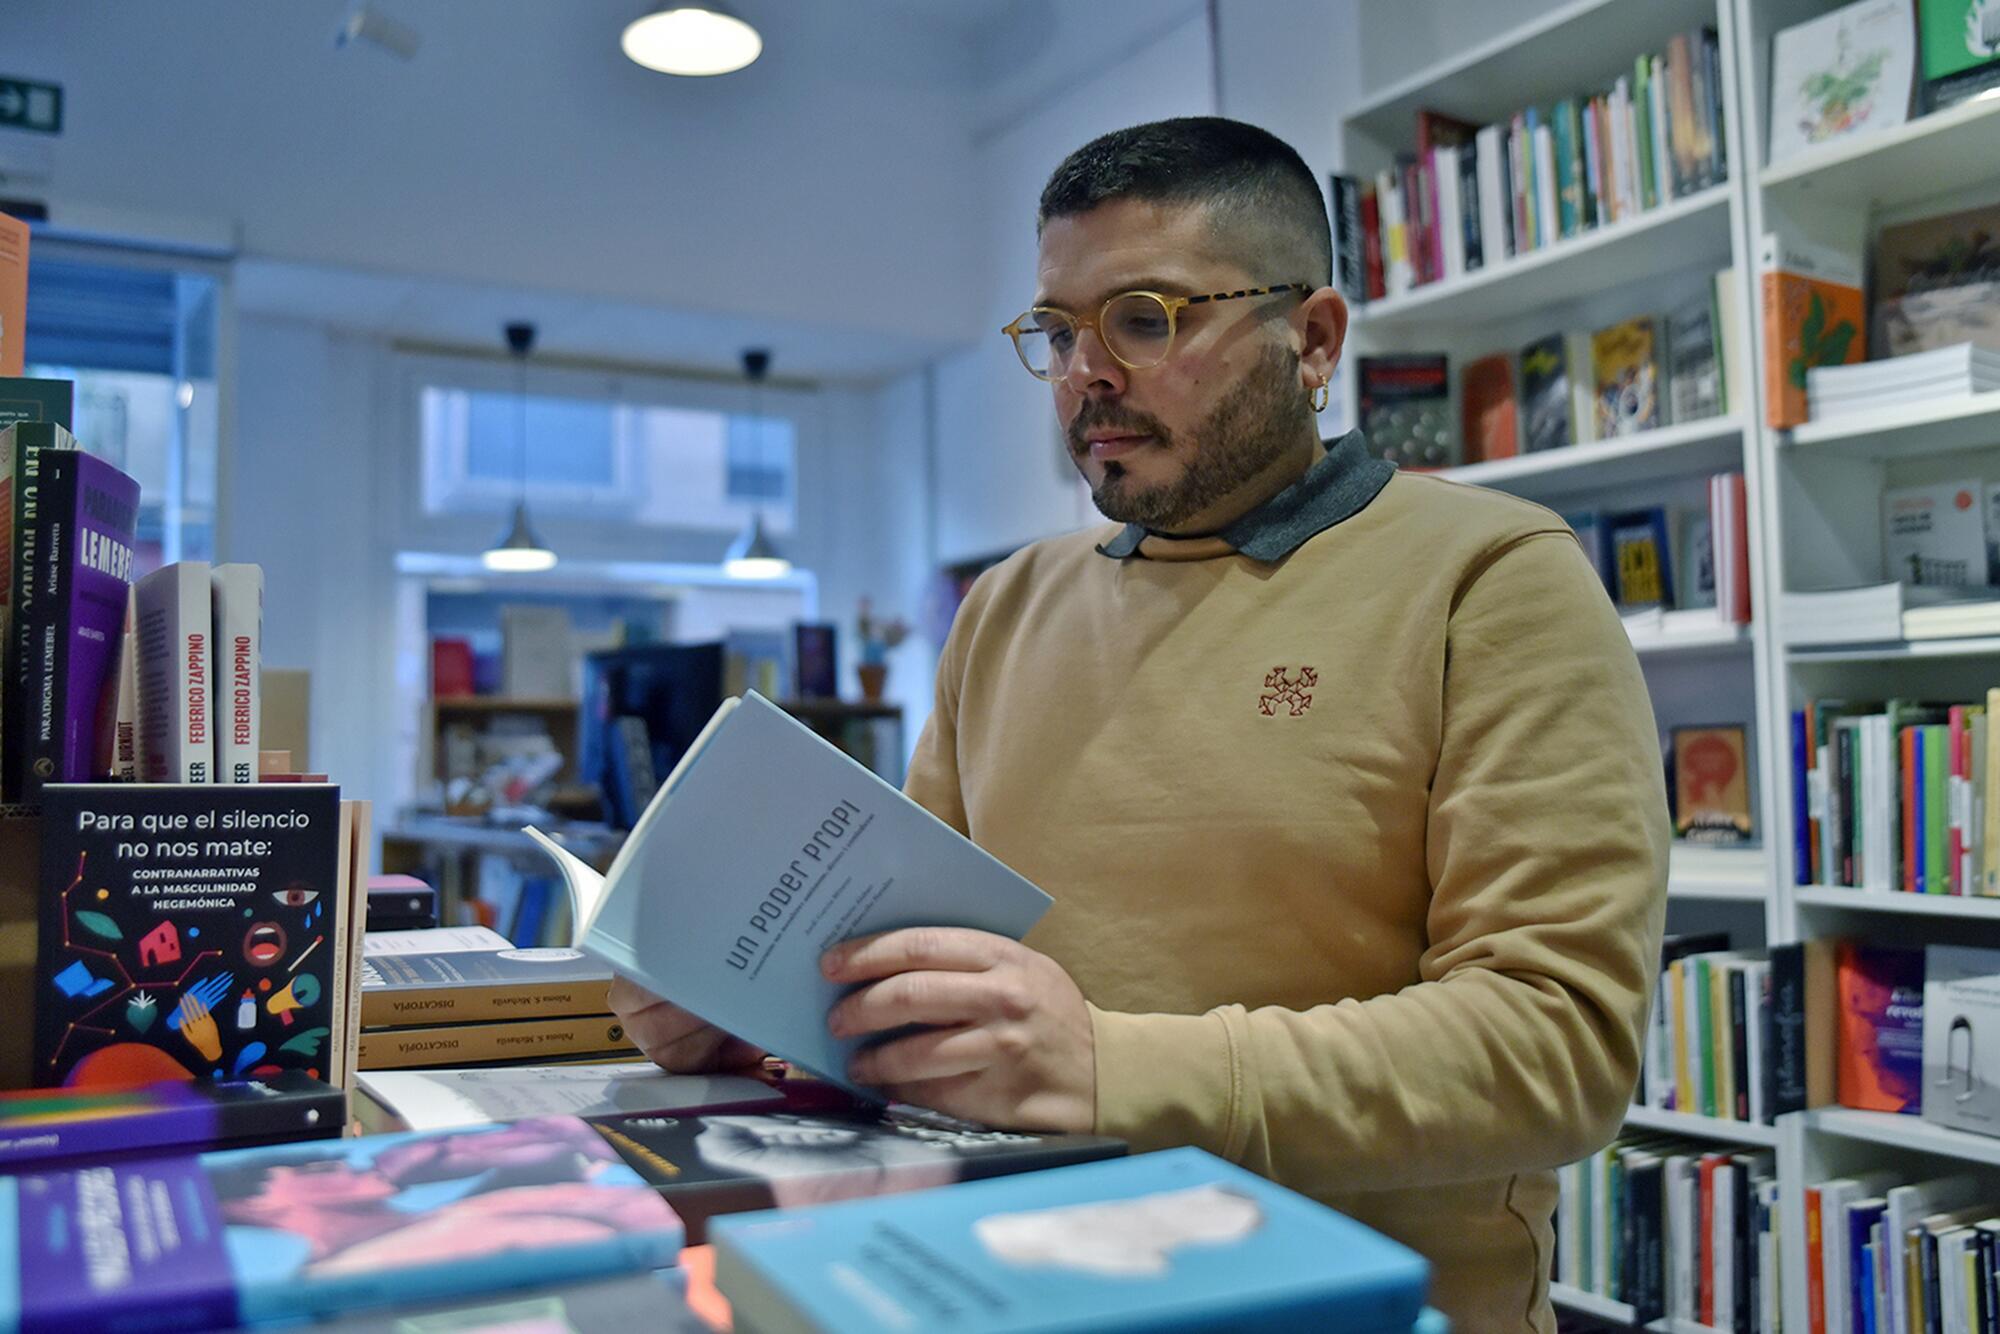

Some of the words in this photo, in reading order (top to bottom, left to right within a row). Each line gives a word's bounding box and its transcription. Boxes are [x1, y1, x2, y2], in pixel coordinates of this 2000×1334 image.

[49, 523, 60, 561] Barretta
[44, 623, 56, 672] LEMEBEL
[188, 633, 205, 685] ZAPPINO
[234, 636, 251, 687] ZAPPINO
[41, 675, 53, 741] PARADIGMA
[189, 687, 205, 744] FEDERICO
[234, 690, 251, 745] FEDERICO
[190, 762, 206, 784] EER
[234, 763, 250, 784] EER
[79, 811, 135, 831] Para
[142, 814, 189, 833] que
[195, 810, 215, 829] el
[222, 809, 310, 829] silencio
[118, 842, 149, 858] no
[156, 841, 199, 857] nos
[205, 839, 272, 857] mate:
[132, 867, 260, 880] CONTRANARRATIVAS
[131, 886, 141, 895] A
[144, 885, 160, 894] LA
[163, 883, 257, 894] MASCULINIDAD
[153, 896, 236, 910] HEGEMÓNICA
[393, 1000, 456, 1013] DISCATOPÍA
[492, 996, 532, 1007] Michavila
[398, 1040, 459, 1053] DISCATOPÍA
[496, 1034, 534, 1045] Michavila
